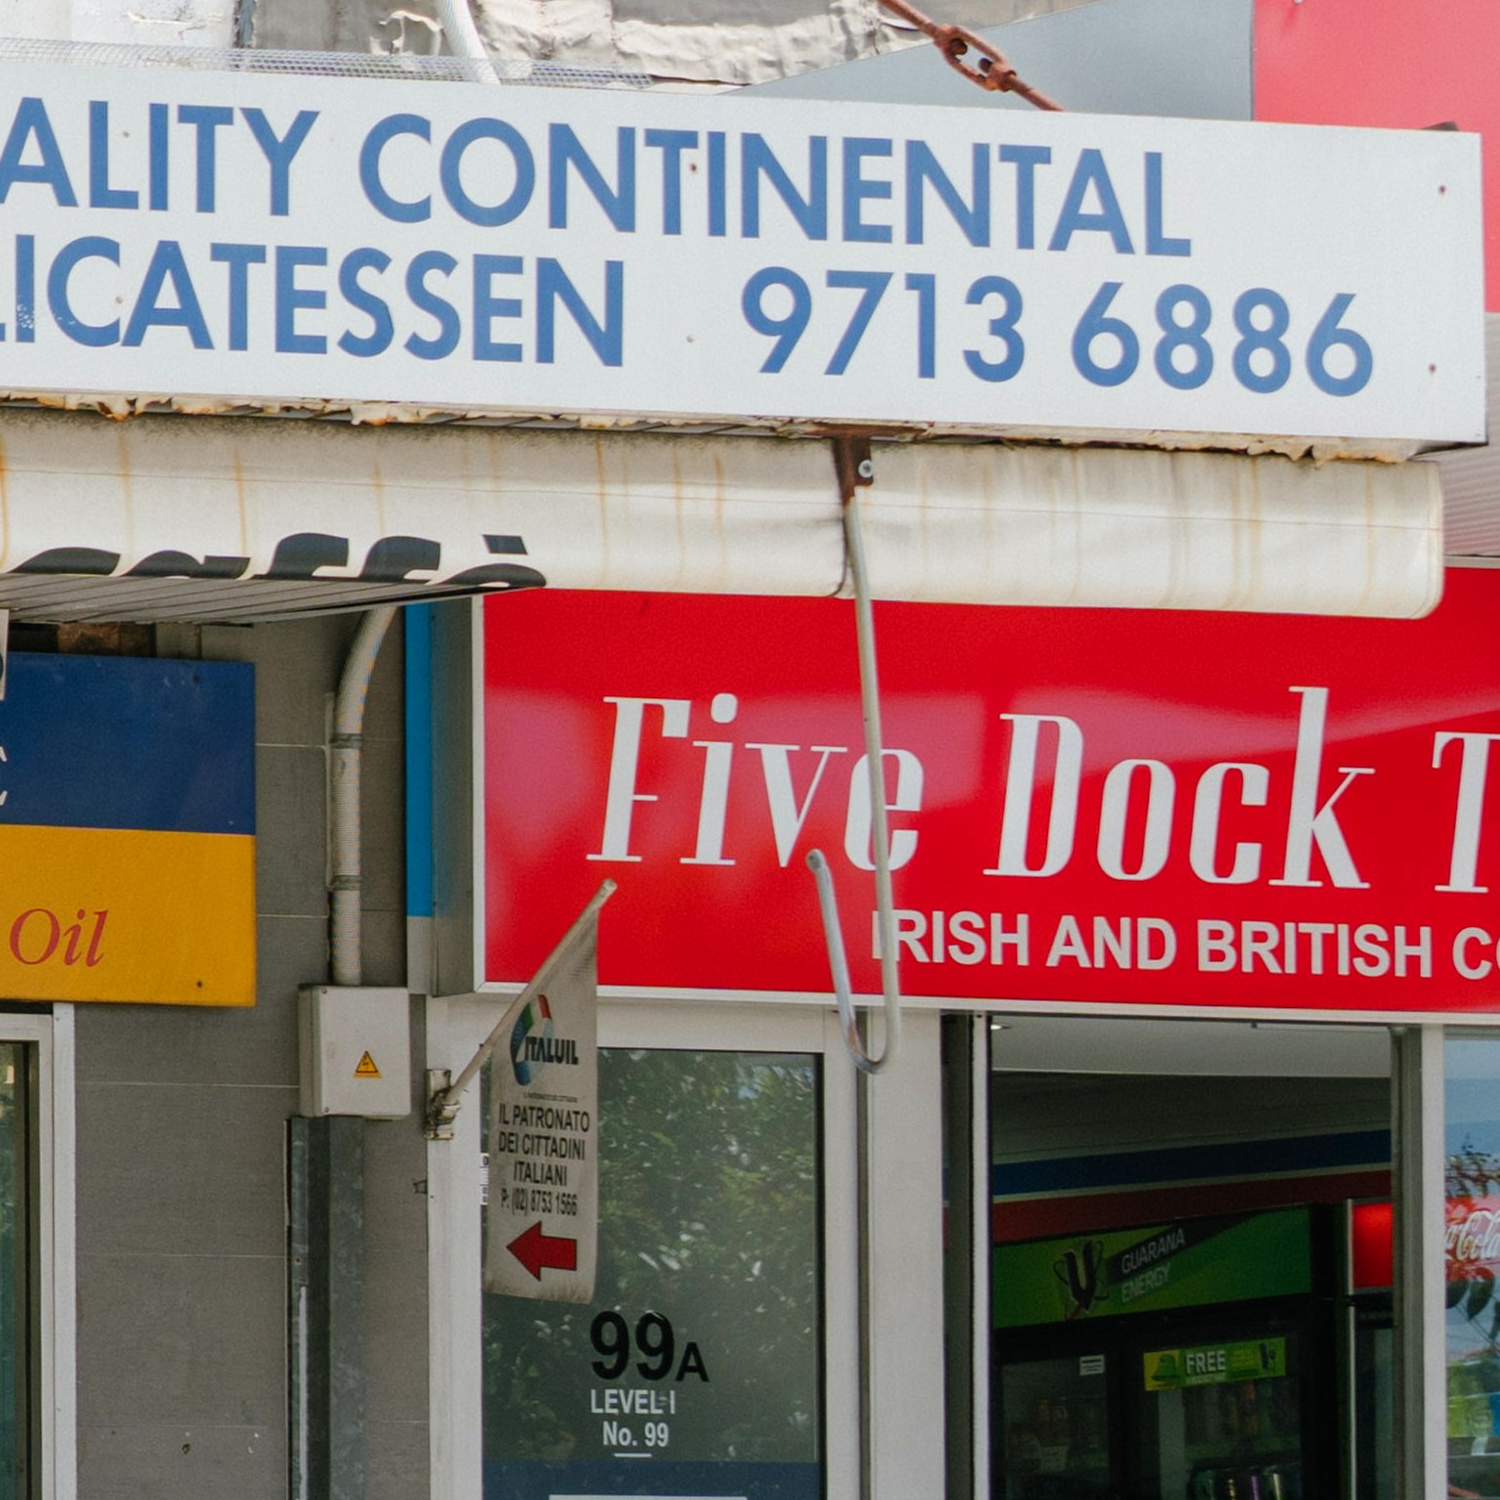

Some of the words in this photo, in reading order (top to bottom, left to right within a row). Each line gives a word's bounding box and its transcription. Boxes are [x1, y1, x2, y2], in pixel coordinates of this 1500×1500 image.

[359, 112, 1192, 257] CONTINENTAL
[741, 266, 1024, 384] 9713
[1070, 280, 1374, 398] 6886
[586, 692, 924, 874] Five
[984, 686, 1375, 890] Dock
[9, 907, 110, 968] Oil
[1045, 915, 1178, 971] AND
[1197, 920, 1433, 979] BRITISH
[524, 1036, 579, 1065] ITALUIL
[513, 1104, 590, 1133] PATRONATO
[499, 1131, 519, 1153] DEI
[522, 1134, 586, 1161] CITTADINI
[514, 1160, 567, 1187] ITALIANI
[512, 1188, 528, 1217] (02)
[531, 1189, 552, 1214] 8753
[1120, 1227, 1187, 1275] GUARANA
[1120, 1263, 1172, 1304] ENERGY
[1186, 1350, 1227, 1375] FREE
[590, 1389, 661, 1414] LEVEL
[603, 1422, 638, 1447] No.
[645, 1421, 669, 1447] 99
